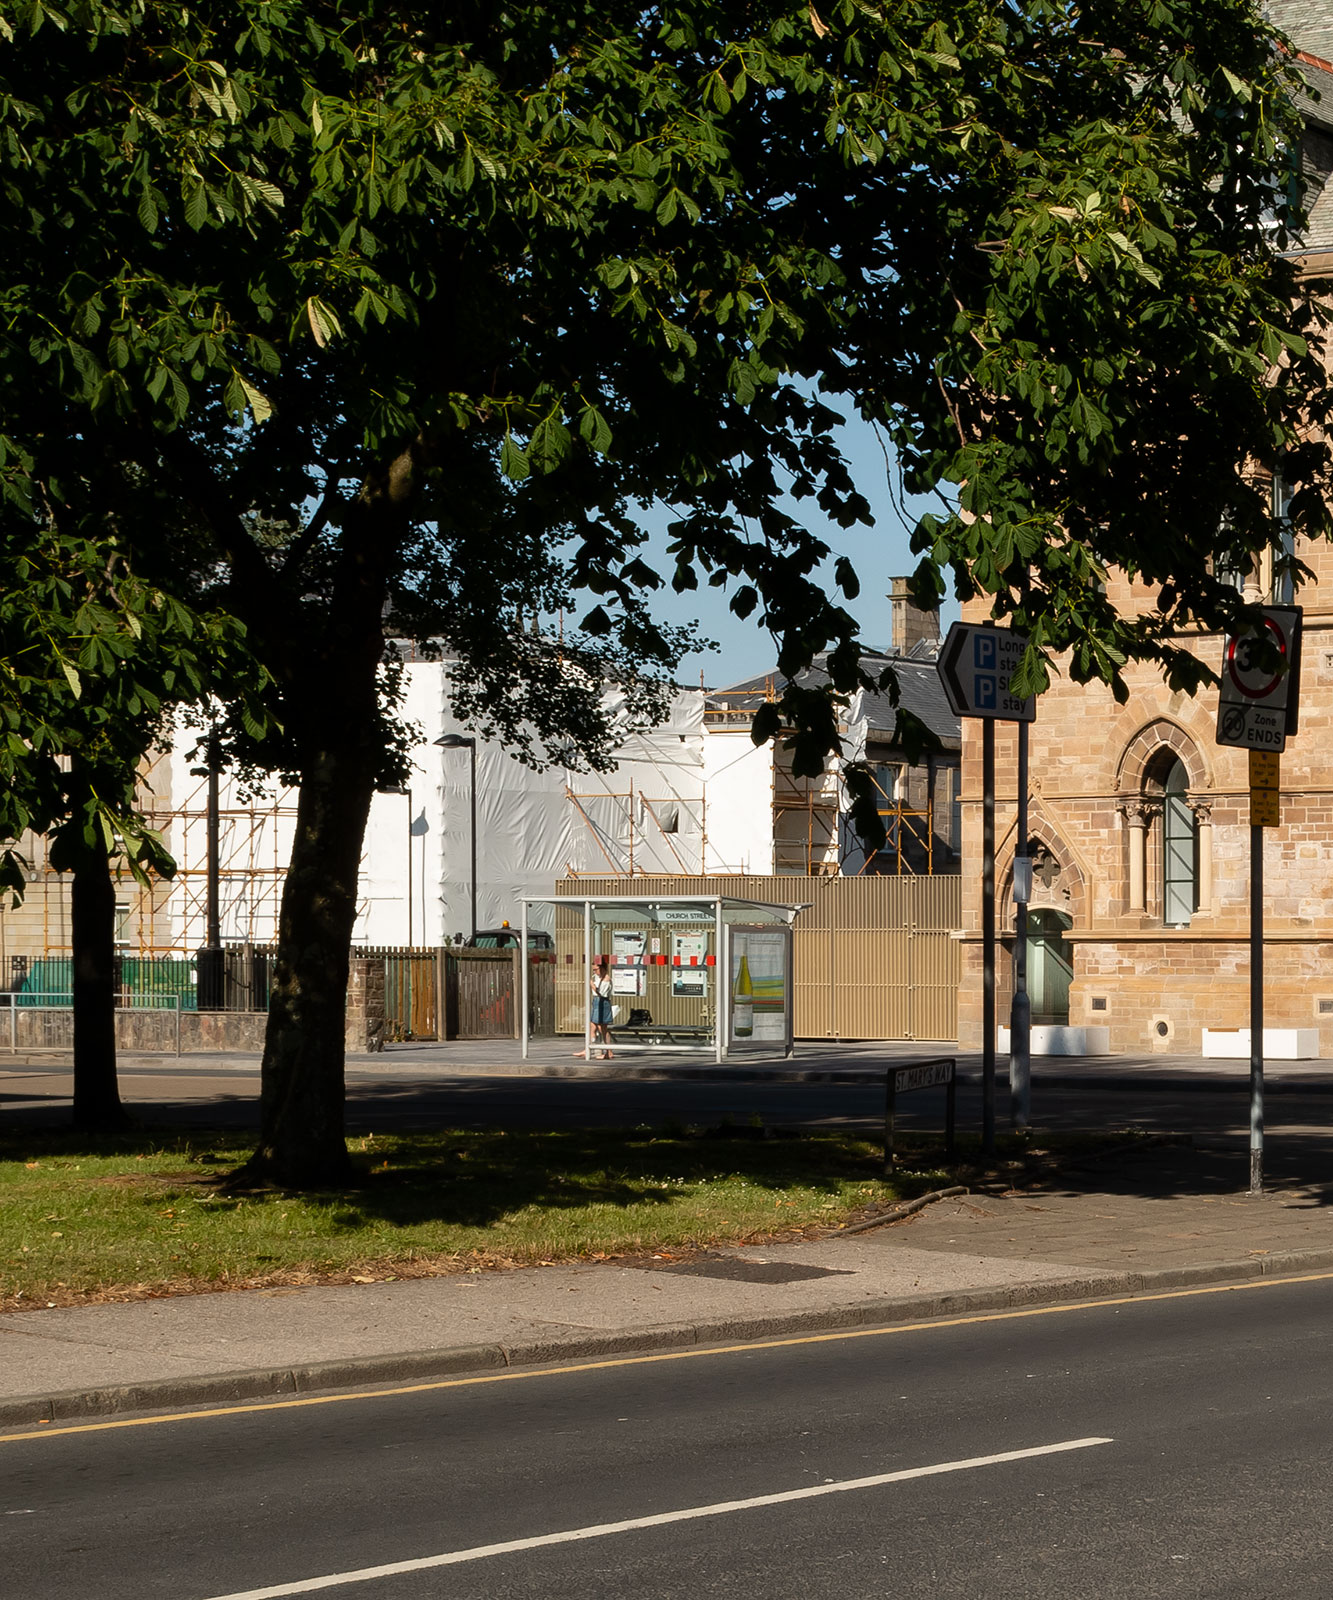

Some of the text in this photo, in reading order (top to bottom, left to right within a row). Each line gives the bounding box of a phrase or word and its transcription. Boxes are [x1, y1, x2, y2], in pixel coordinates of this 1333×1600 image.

[979, 636, 1026, 666] P Long
[1000, 657, 1017, 672] sta
[979, 679, 993, 706] P
[1002, 697, 1027, 715] stay
[1254, 713, 1278, 727] Zone
[1247, 728, 1282, 745] ENDS
[666, 912, 689, 920] CHURCH
[935, 1062, 952, 1083] WAY
